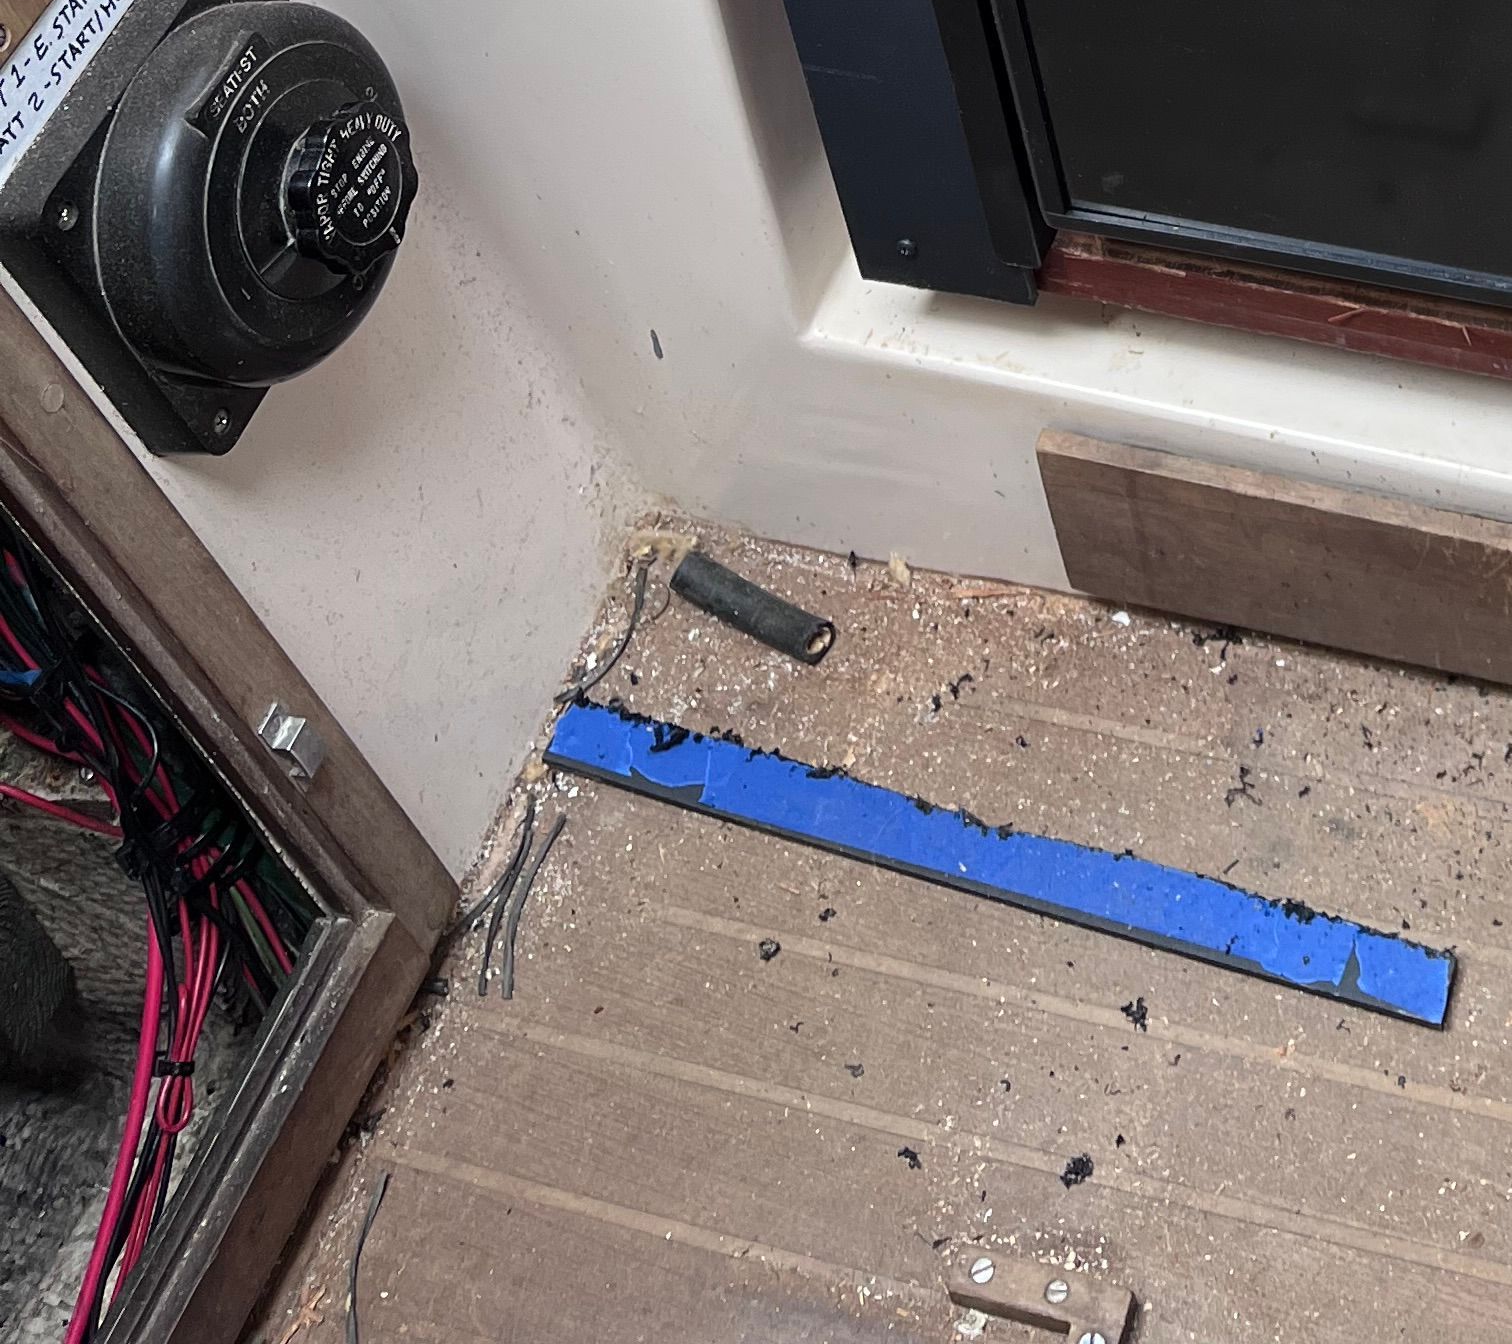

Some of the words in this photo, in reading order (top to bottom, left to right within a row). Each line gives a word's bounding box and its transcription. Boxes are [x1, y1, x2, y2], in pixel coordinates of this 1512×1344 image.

[317, 138, 338, 187] TIGHT
[374, 113, 402, 142] DUTY
[357, 143, 388, 186] SWITCHING
[330, 173, 348, 199] STOP
[353, 202, 365, 218] TO
